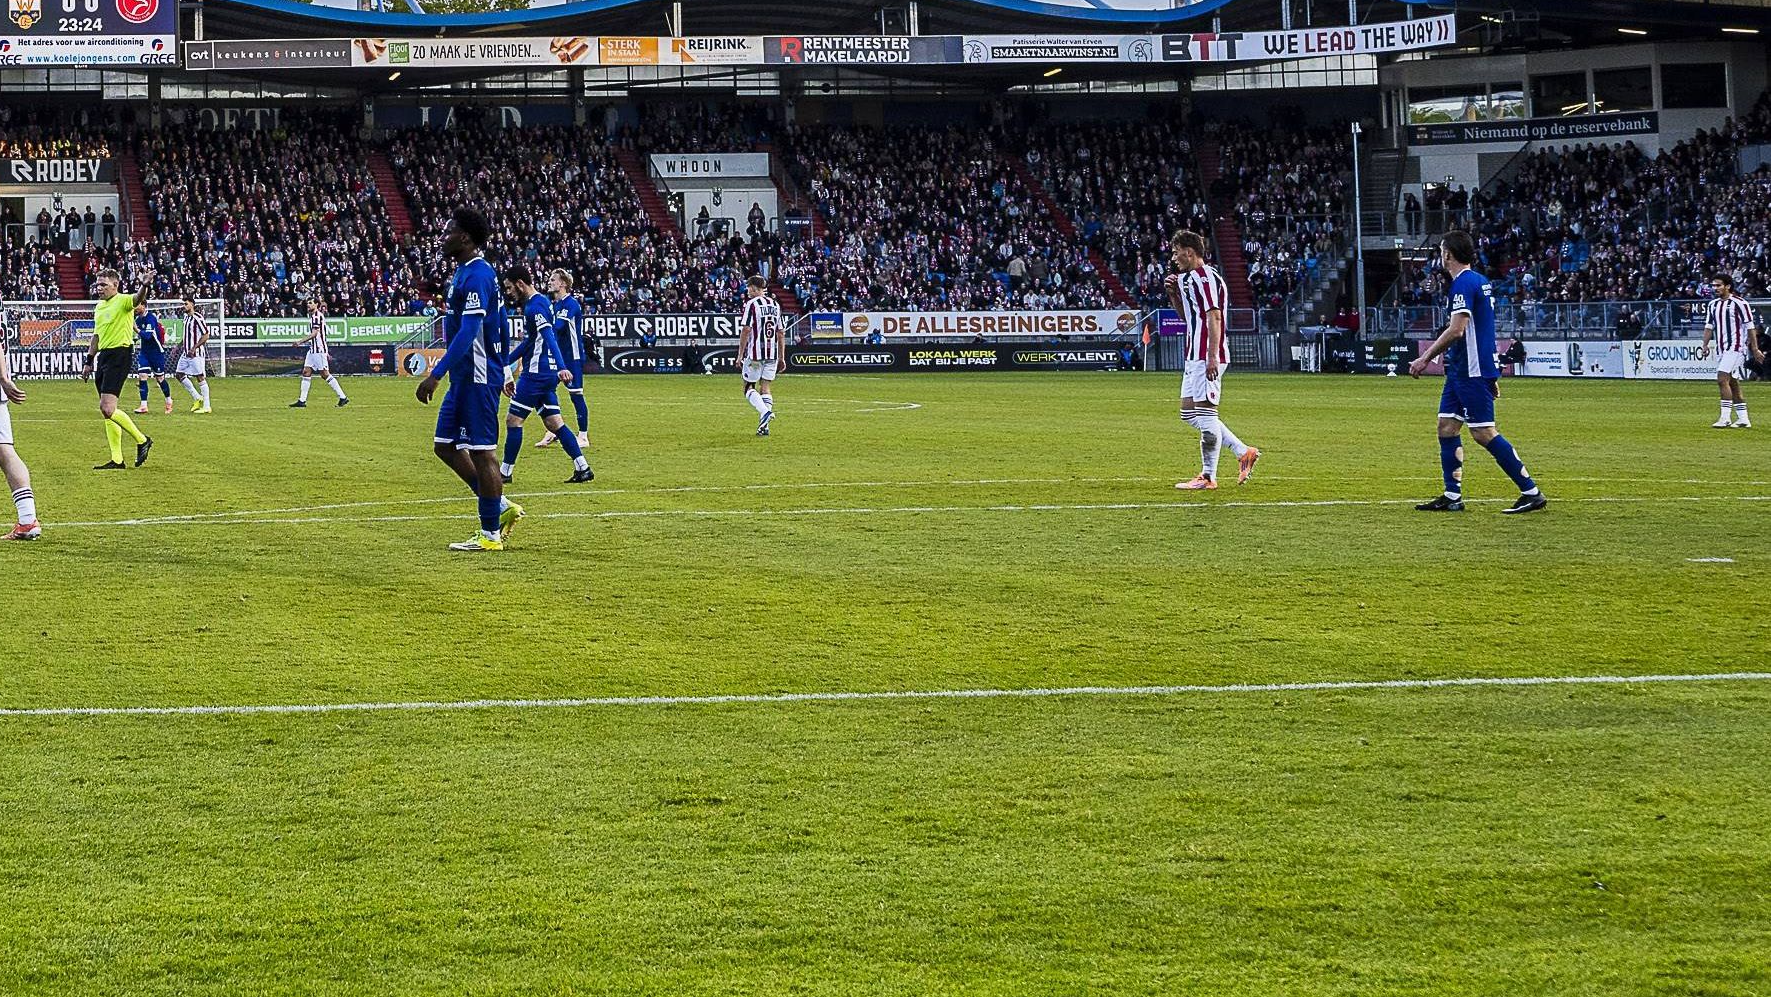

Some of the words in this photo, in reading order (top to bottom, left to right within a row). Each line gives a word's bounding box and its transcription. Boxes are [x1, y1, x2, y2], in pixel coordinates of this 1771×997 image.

[58, 18, 103, 32] 23:24
[17, 38, 31, 46] Het
[32, 38, 54, 46] adres
[87, 38, 144, 48] airconditioning
[607, 40, 641, 49] STERK
[688, 38, 746, 51] REIJRINK
[803, 37, 910, 50] RENTMEESTER
[1264, 34, 1299, 55] WE
[1305, 31, 1357, 53] LEAD
[1361, 27, 1396, 50] THE
[1401, 22, 1433, 45] WAY
[389, 43, 408, 53] Floor
[413, 46, 426, 60] ZO
[430, 45, 461, 59] MAAK
[464, 45, 476, 59] JE
[479, 44, 541, 59] VRIENDEN...
[992, 47, 1117, 58] SMAAKTNAARWINST.NL
[1162, 33, 1244, 61] BTT
[27, 54, 136, 64] www.koelejongens.com
[140, 53, 175, 65] GREE
[190, 50, 209, 60] cvt
[217, 51, 270, 60] keukens
[285, 49, 347, 59] interieur
[804, 50, 910, 63] MAKELAARDIJ
[1463, 124, 1529, 140] Niemand
[1531, 125, 1548, 140] op
[1550, 120, 1566, 135] de
[1568, 114, 1651, 133] reservebank
[36, 159, 101, 182] ROBEY
[666, 159, 722, 173] WHOON
[655, 316, 709, 337] ROBEY
[883, 315, 911, 334] DE
[915, 313, 1103, 334] ALLESREINIGERS.
[350, 325, 393, 337] BEREIK
[794, 353, 892, 365] WERKTALENT.
[909, 350, 958, 359] LOKAAL
[959, 350, 996, 359] WERK
[1016, 350, 1118, 363] WERKTALENT.
[621, 357, 684, 367] FITNESS
[909, 358, 931, 366] DAT
[935, 358, 952, 366] BIJ
[967, 358, 997, 366] PAST
[1650, 365, 1673, 374] Specialist
